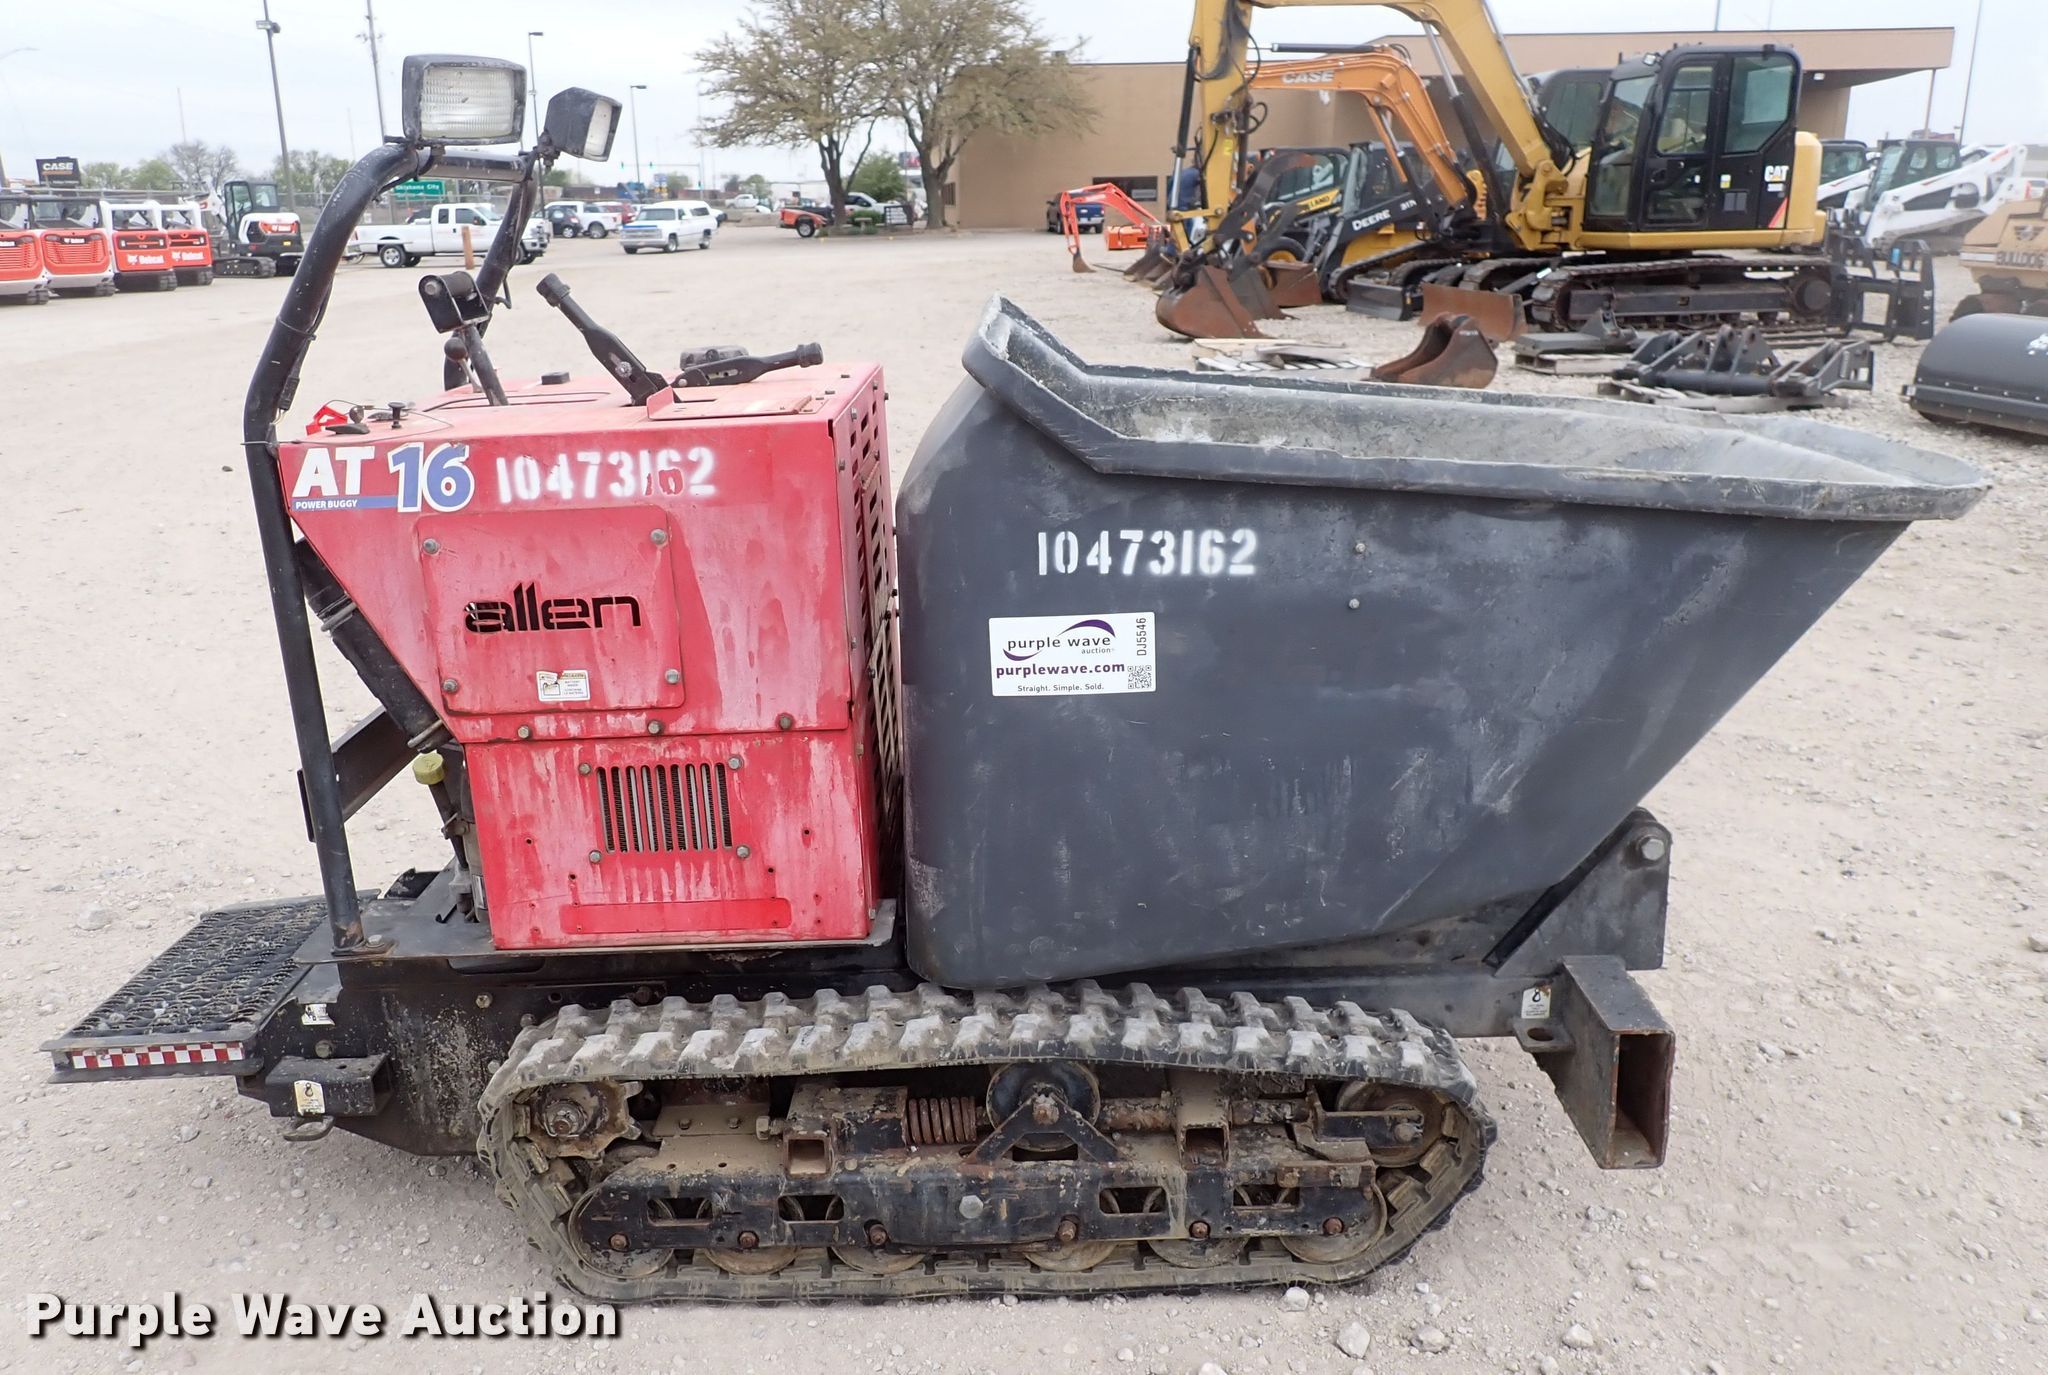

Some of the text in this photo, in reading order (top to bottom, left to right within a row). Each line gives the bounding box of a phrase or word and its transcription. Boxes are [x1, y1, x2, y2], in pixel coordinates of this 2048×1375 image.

[1282, 69, 1335, 83] CASE
[43, 162, 74, 171] CASE
[1764, 165, 1790, 182] CAT
[1352, 209, 1391, 231] DEERE
[292, 442, 475, 513] AT 16
[496, 447, 716, 504] 10473162
[295, 499, 358, 510] POWER BUGGY
[1038, 528, 1257, 576] 10473162
[464, 582, 641, 633] allen
[1007, 636, 1111, 651] purple wave
[1136, 617, 1147, 656] DJ5546
[1081, 646, 1111, 655] auction
[996, 663, 1125, 679] purplewave.com
[1017, 683, 1104, 694] Straight. Simple. Sold.
